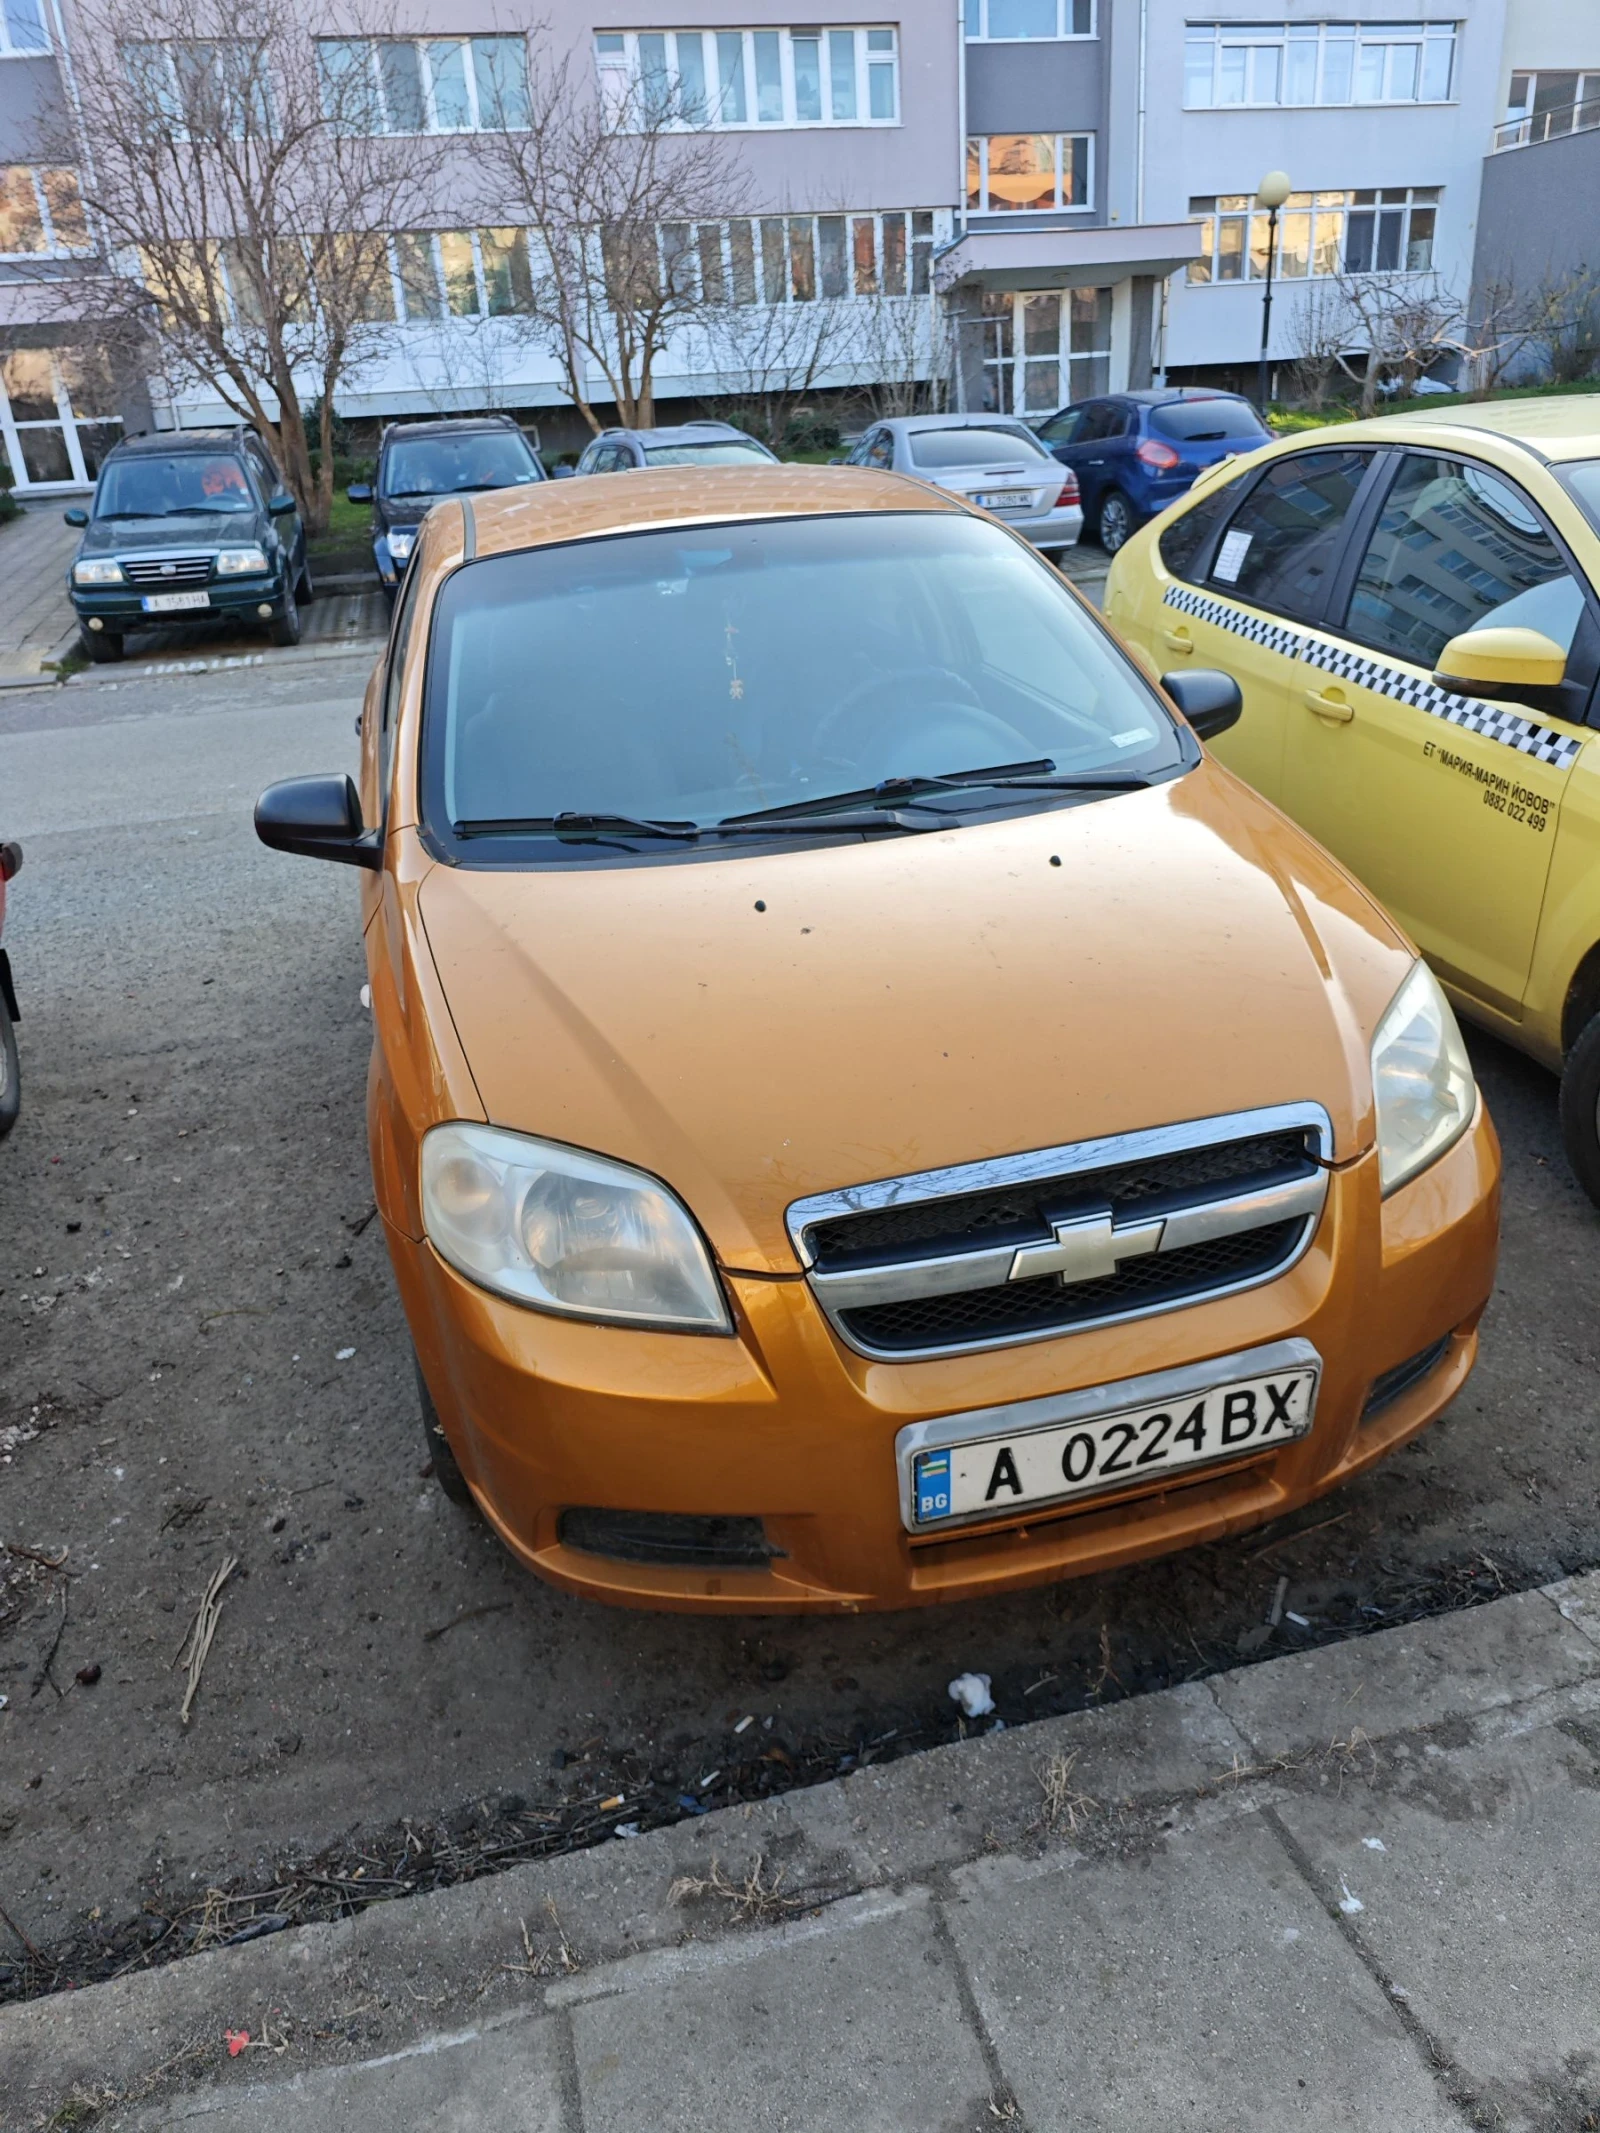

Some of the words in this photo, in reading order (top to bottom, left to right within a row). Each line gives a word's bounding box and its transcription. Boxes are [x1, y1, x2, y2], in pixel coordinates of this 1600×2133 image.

[1423, 741, 1437, 758] ЕТ
[1483, 790, 1506, 813] 0882
[1507, 804, 1525, 823] 022
[1527, 812, 1546, 832] 499
[985, 1447, 1023, 1501] A
[920, 1493, 948, 1512] BG
